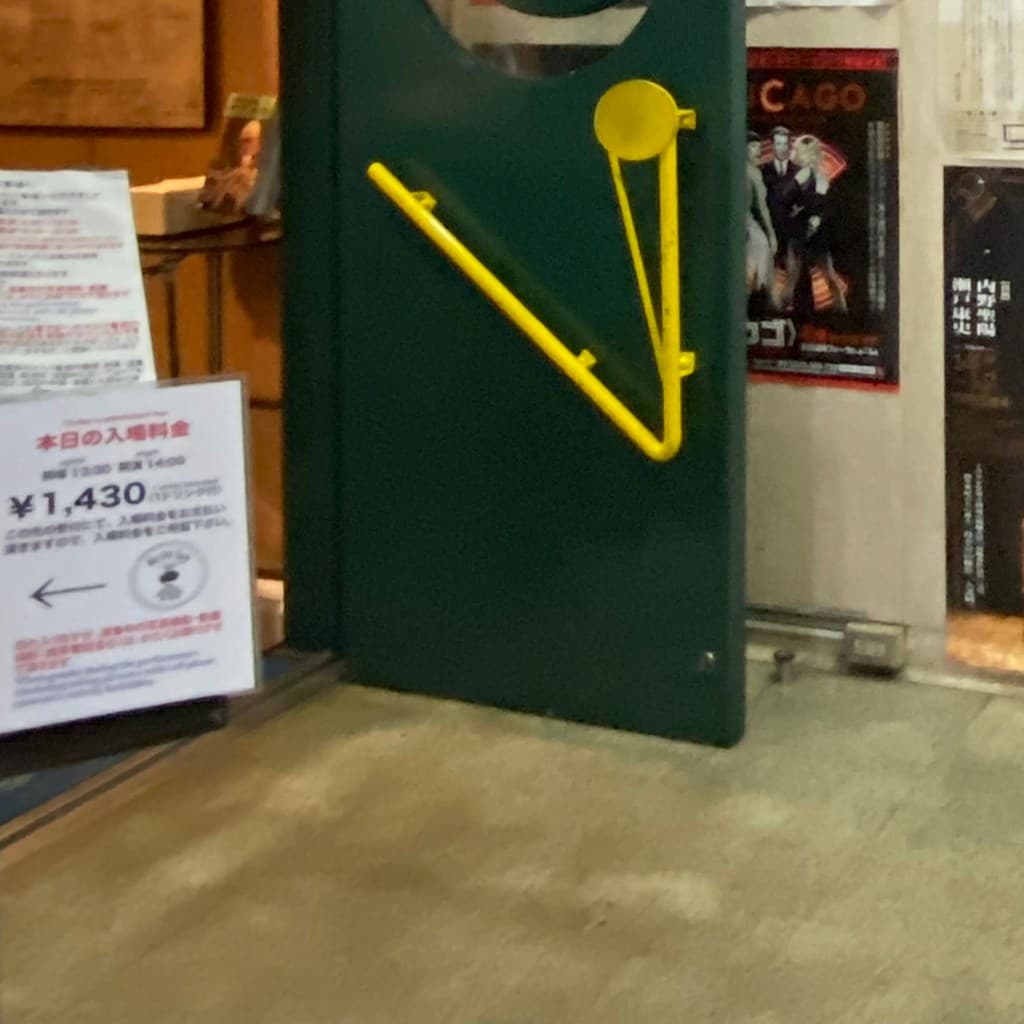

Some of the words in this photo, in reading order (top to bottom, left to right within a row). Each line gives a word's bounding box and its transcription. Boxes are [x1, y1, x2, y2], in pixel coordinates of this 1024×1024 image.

[36, 420, 192, 451] 本日の入場料金
[10, 481, 147, 520] ¥1,430
